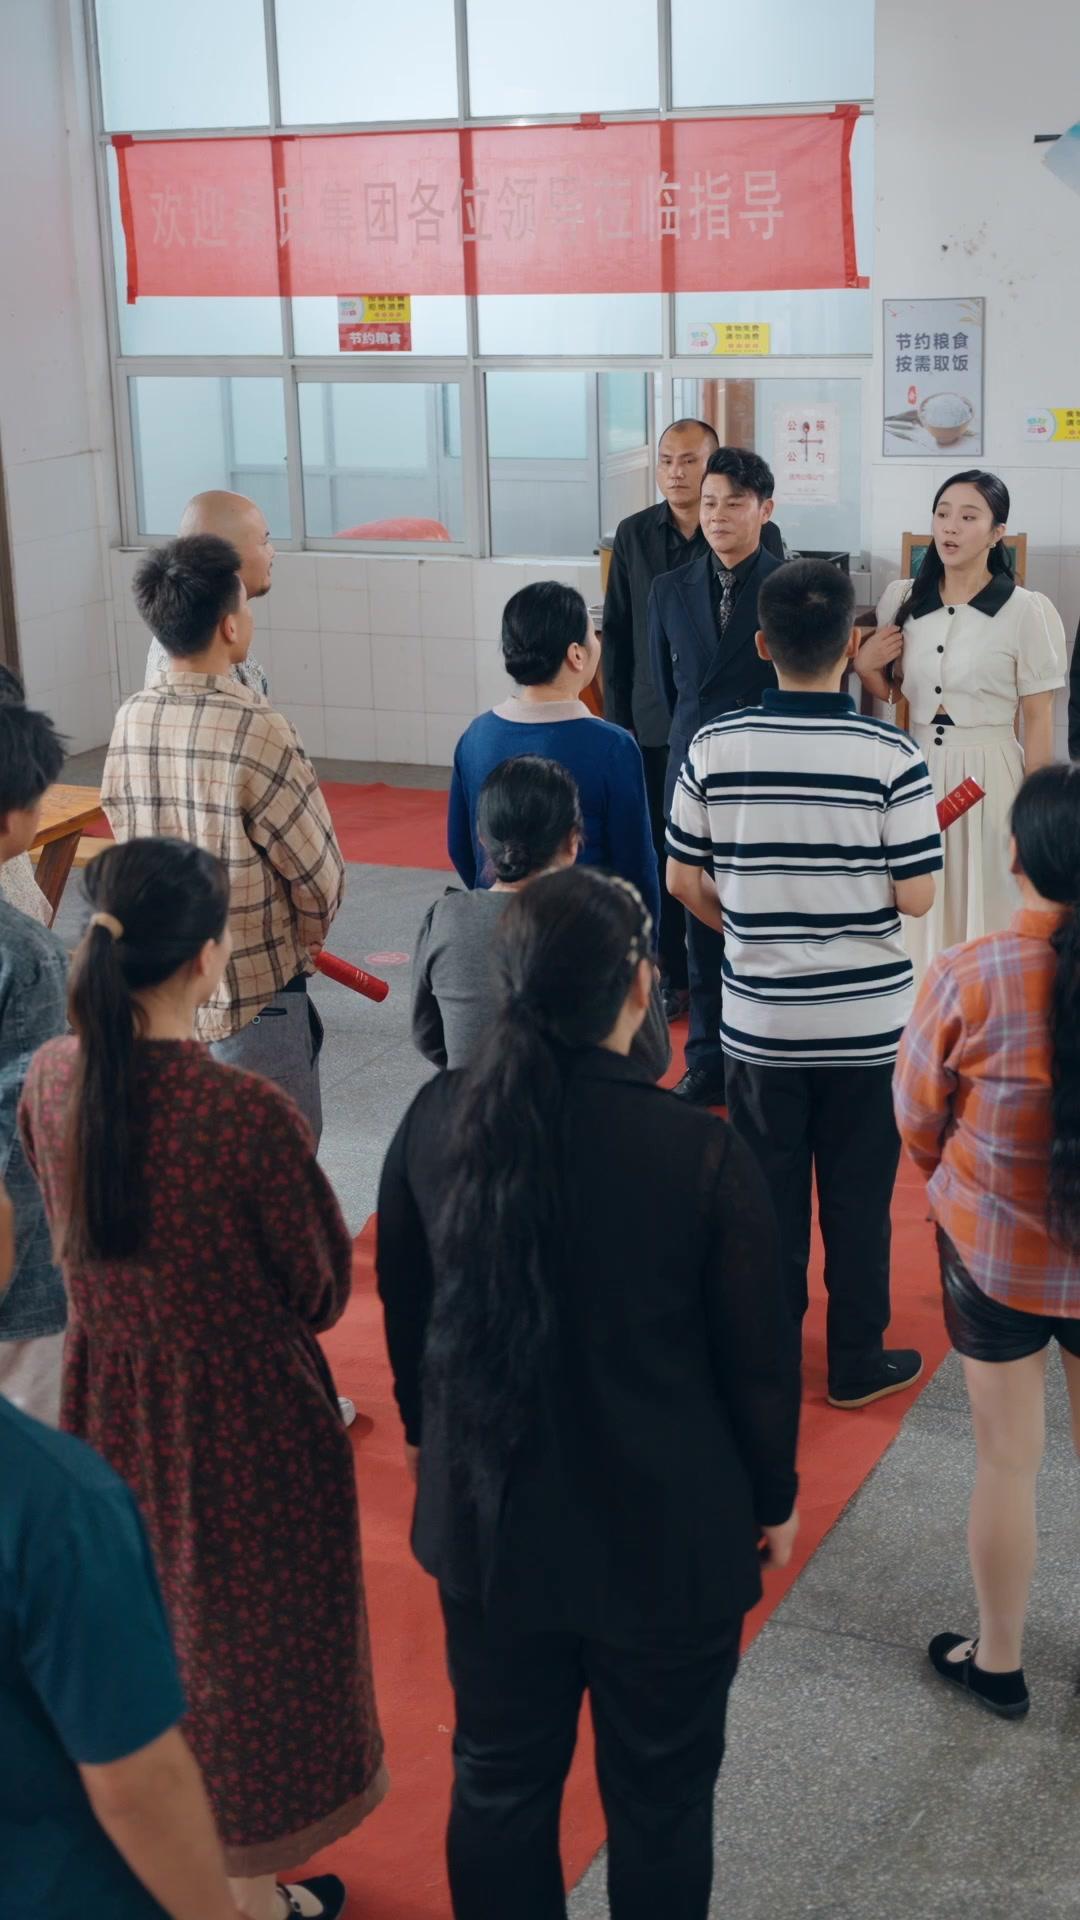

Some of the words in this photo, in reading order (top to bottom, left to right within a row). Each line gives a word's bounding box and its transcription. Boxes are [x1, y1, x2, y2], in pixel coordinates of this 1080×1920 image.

[350, 332, 401, 344] 节约粮食
[896, 332, 969, 351] 节约粮食
[896, 354, 969, 373] 按需取饭
[787, 420, 797, 431] 公
[787, 451, 797, 462] 公
